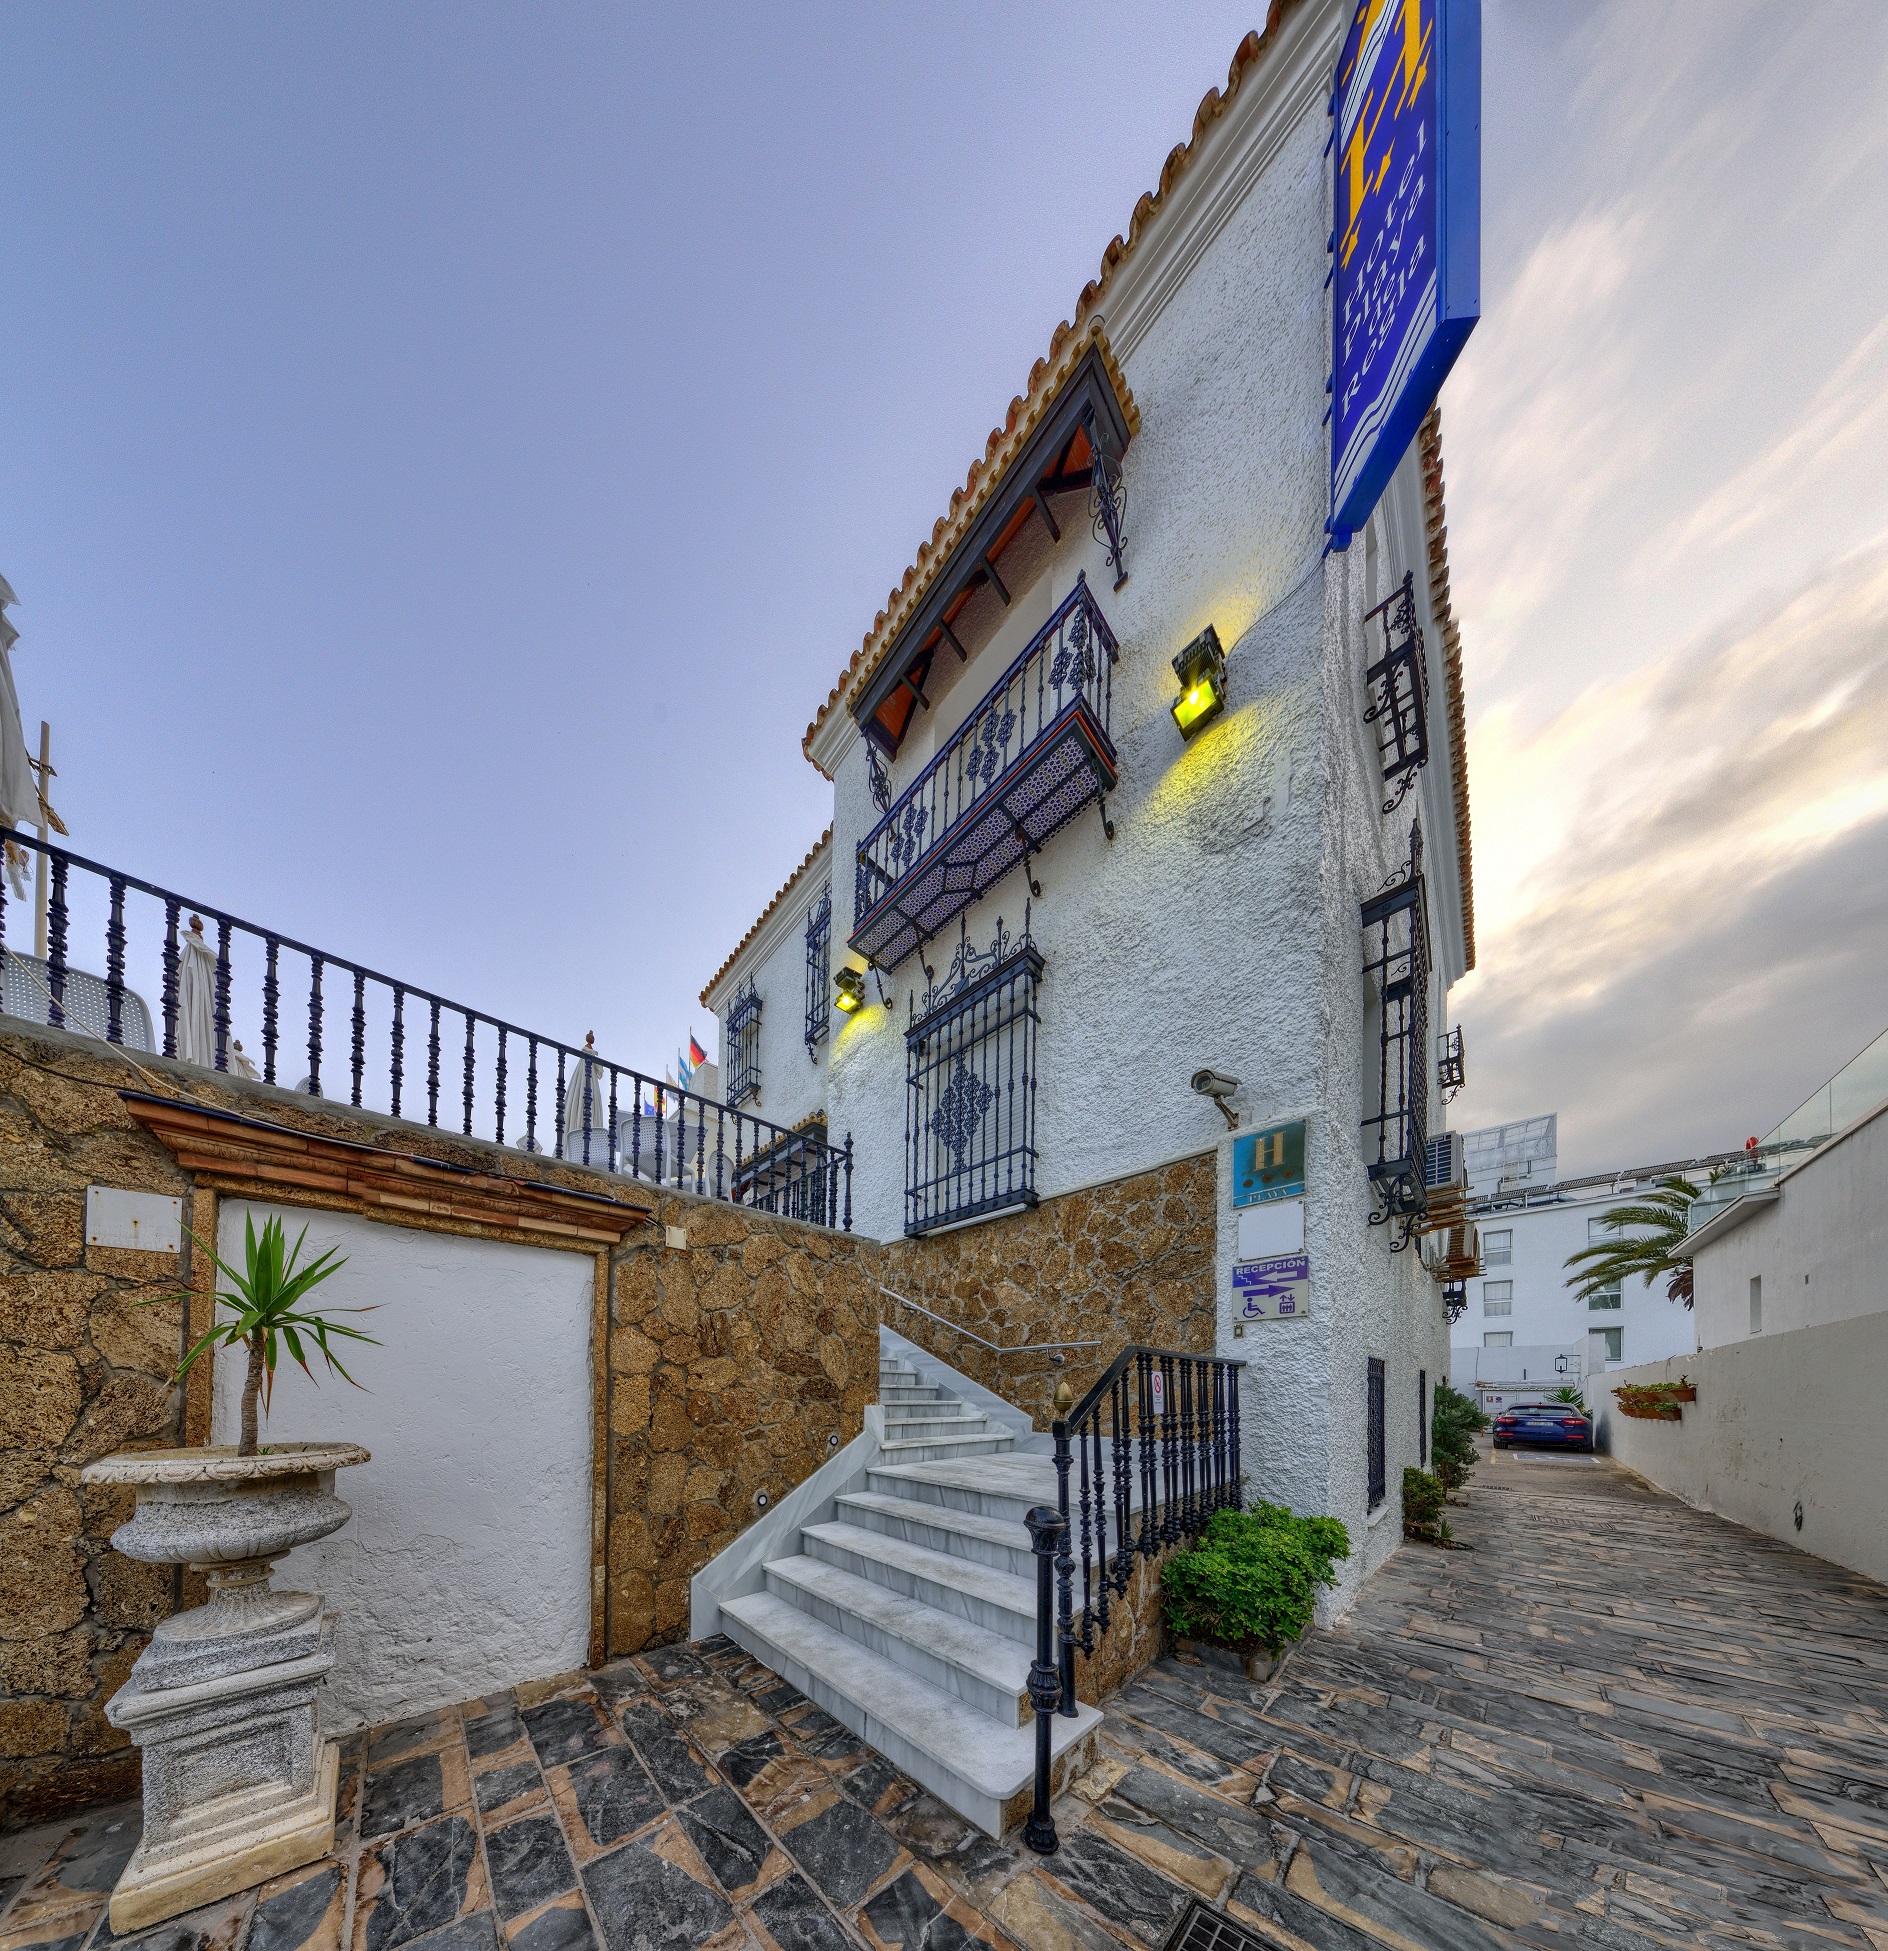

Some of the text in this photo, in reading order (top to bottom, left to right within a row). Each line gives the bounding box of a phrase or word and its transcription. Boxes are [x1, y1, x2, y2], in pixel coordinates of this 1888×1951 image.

[1343, 119, 1427, 331] Hotel
[1343, 174, 1426, 367] Playa
[1341, 235, 1427, 422] Regla
[1369, 272, 1396, 337] de
[1252, 1131, 1287, 1172] H
[1248, 1188, 1288, 1203] PLAYA
[1236, 1258, 1306, 1276] RECEPCIÓN
